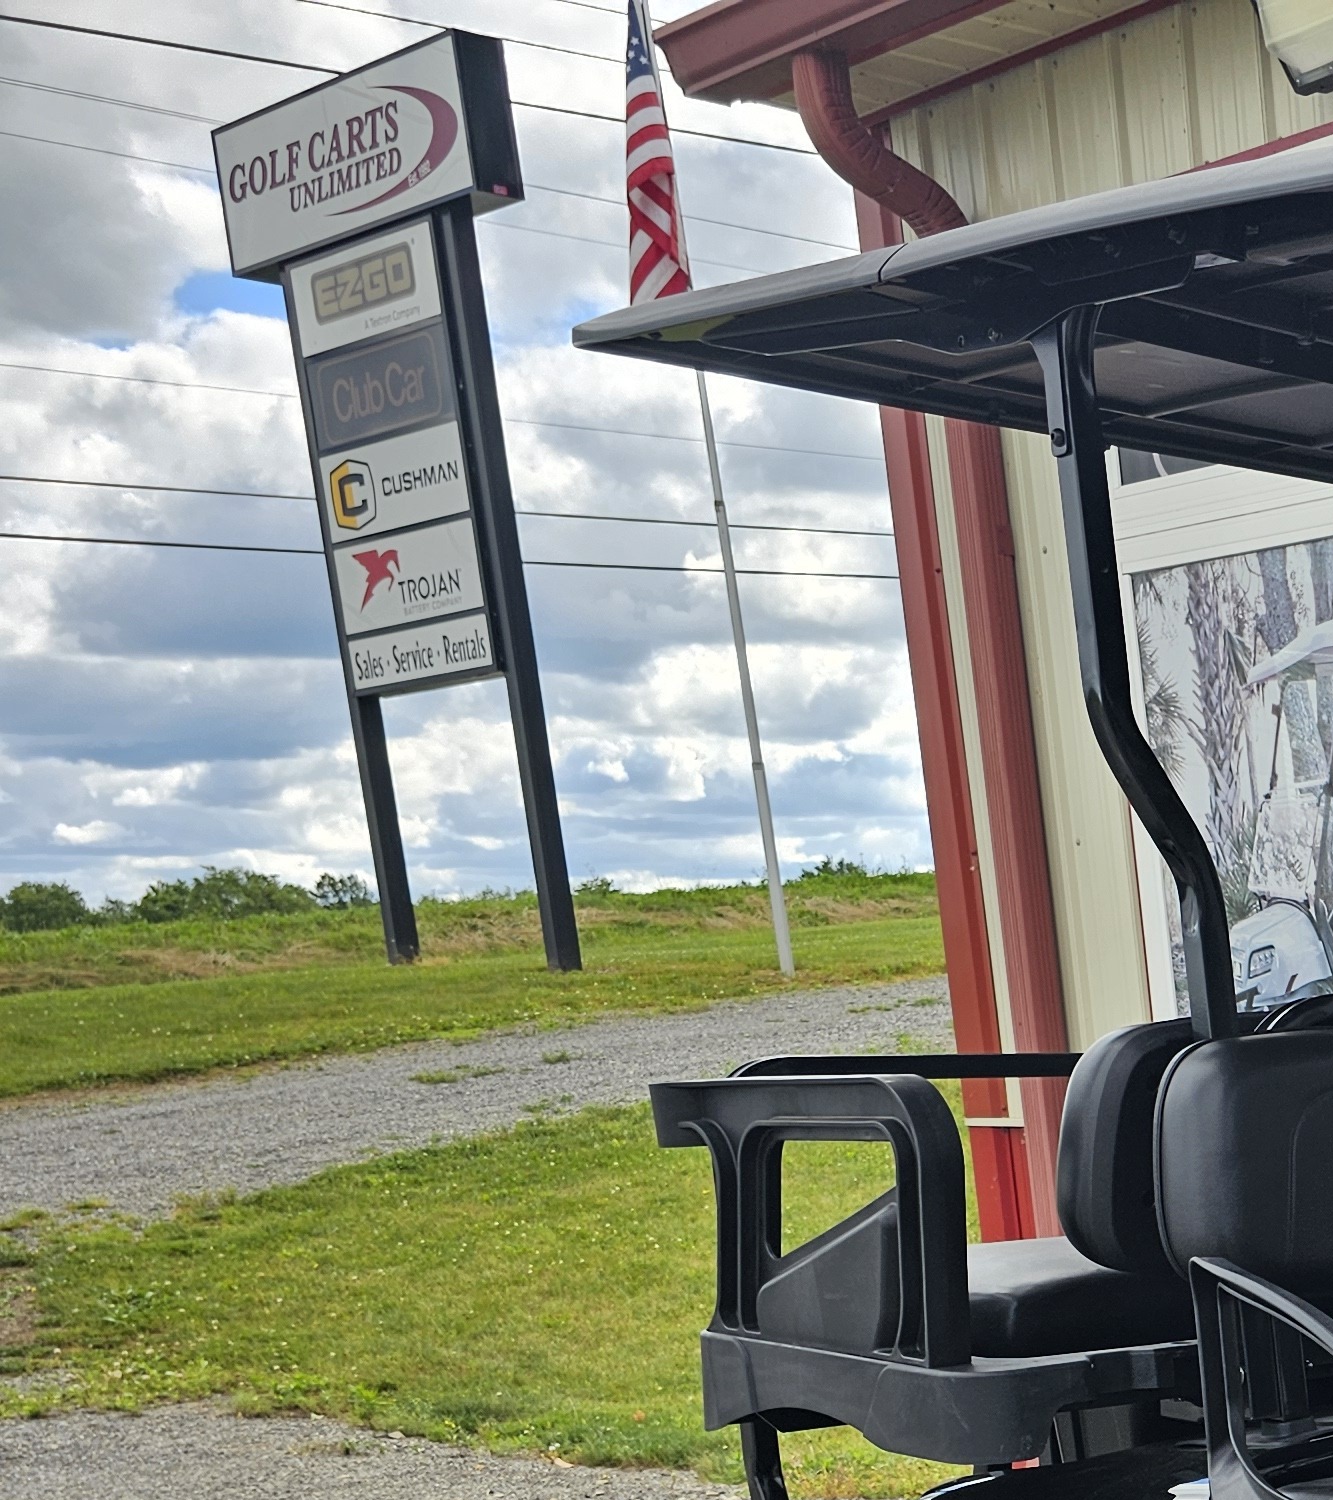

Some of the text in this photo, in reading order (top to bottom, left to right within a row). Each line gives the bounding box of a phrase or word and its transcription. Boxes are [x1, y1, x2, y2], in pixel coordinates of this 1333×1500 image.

[229, 100, 399, 204] GOLF CARTS
[289, 147, 402, 212] UNLIMITED
[332, 361, 425, 423] Club Car
[381, 460, 459, 497] CUSHMAN
[398, 568, 462, 605] TROJAN
[354, 629, 487, 681] Sales Service Rentals
